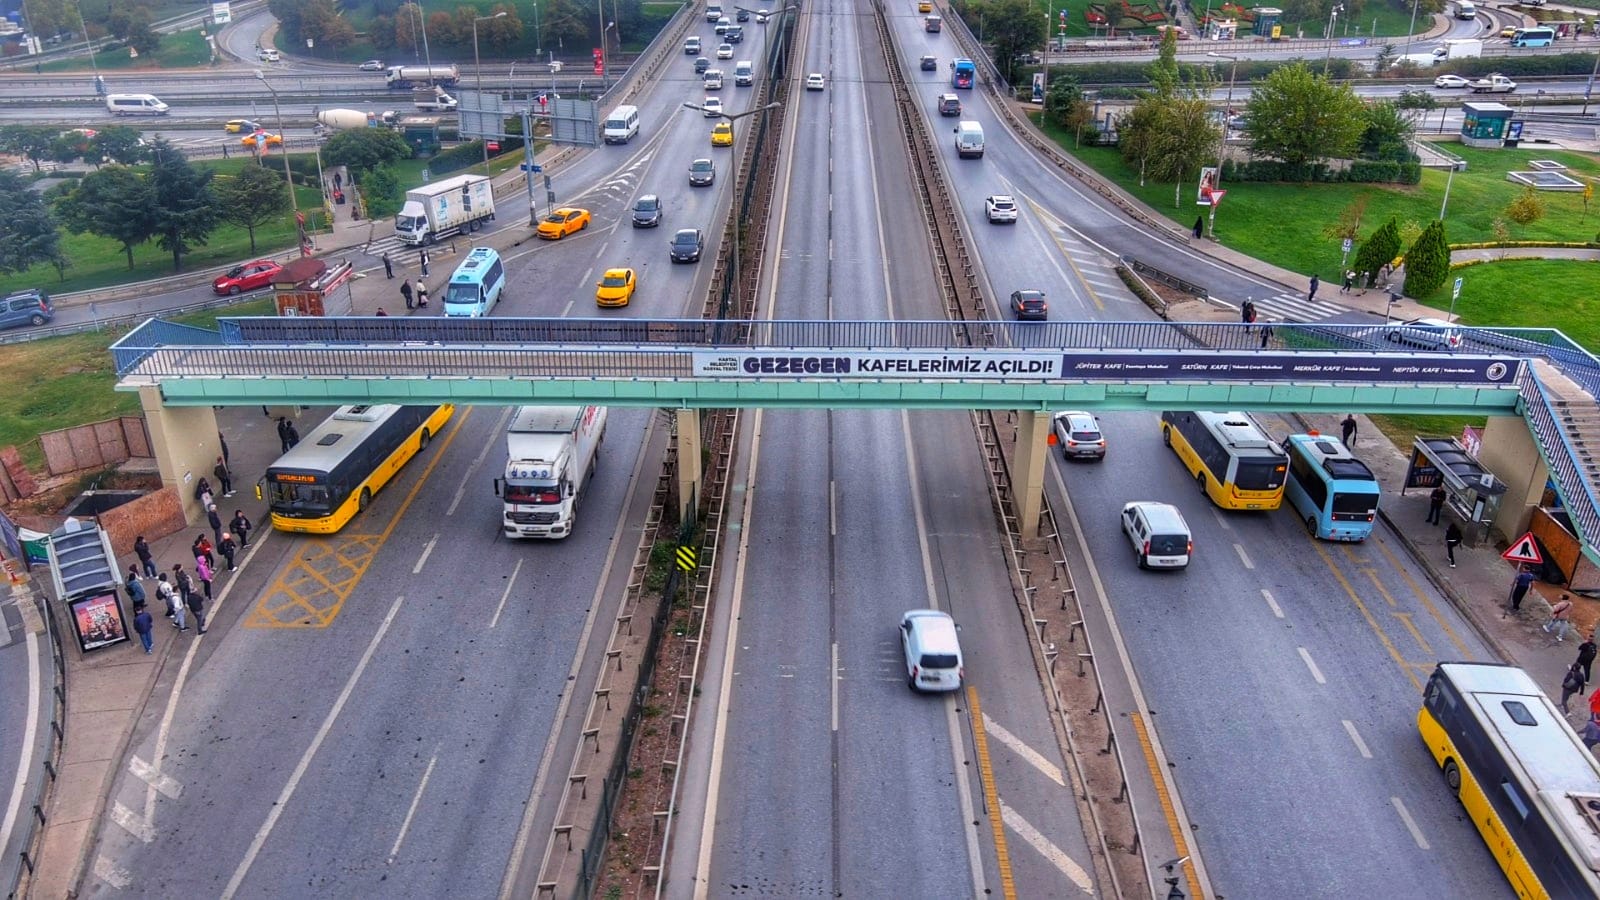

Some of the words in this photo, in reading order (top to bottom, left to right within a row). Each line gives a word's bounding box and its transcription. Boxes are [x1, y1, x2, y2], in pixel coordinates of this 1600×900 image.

[743, 357, 851, 374] GEZEGEN
[857, 356, 981, 373] KAFELERİMİZ
[984, 359, 1054, 376] AÇILDI!
[1075, 361, 1102, 369] JÜPİTER
[1181, 362, 1208, 370] SATÜRN
[1392, 365, 1420, 373] NEPTÜN
